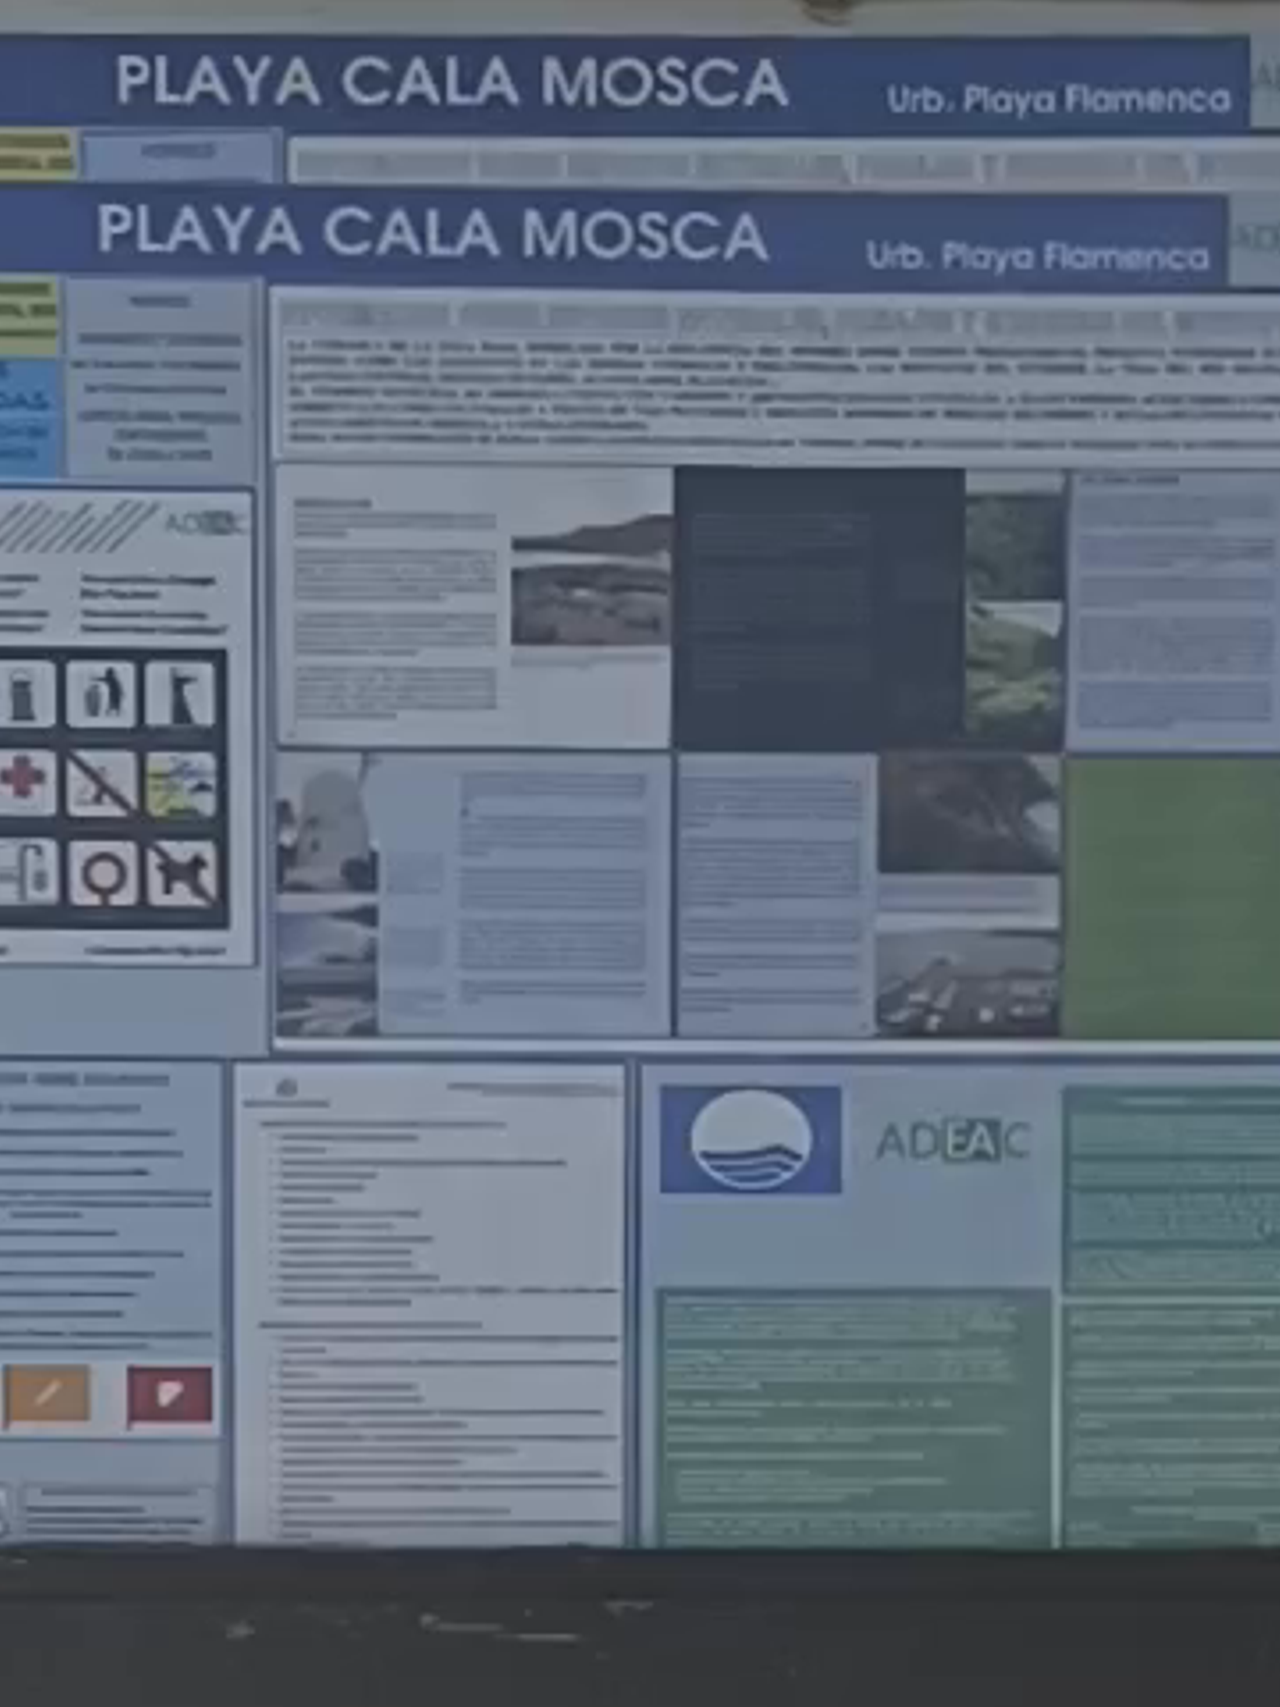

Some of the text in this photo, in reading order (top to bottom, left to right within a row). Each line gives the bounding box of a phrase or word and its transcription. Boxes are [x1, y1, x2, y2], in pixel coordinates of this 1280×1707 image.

[116, 54, 790, 109] PLAYA CALA MOSCA
[886, 83, 1233, 122] Urb. Playa Flamenca
[97, 204, 769, 261] PLAYA CALA MOSCA
[865, 239, 1212, 278] Urb. Playa Flamenca
[875, 1116, 1032, 1164] ADEAC
